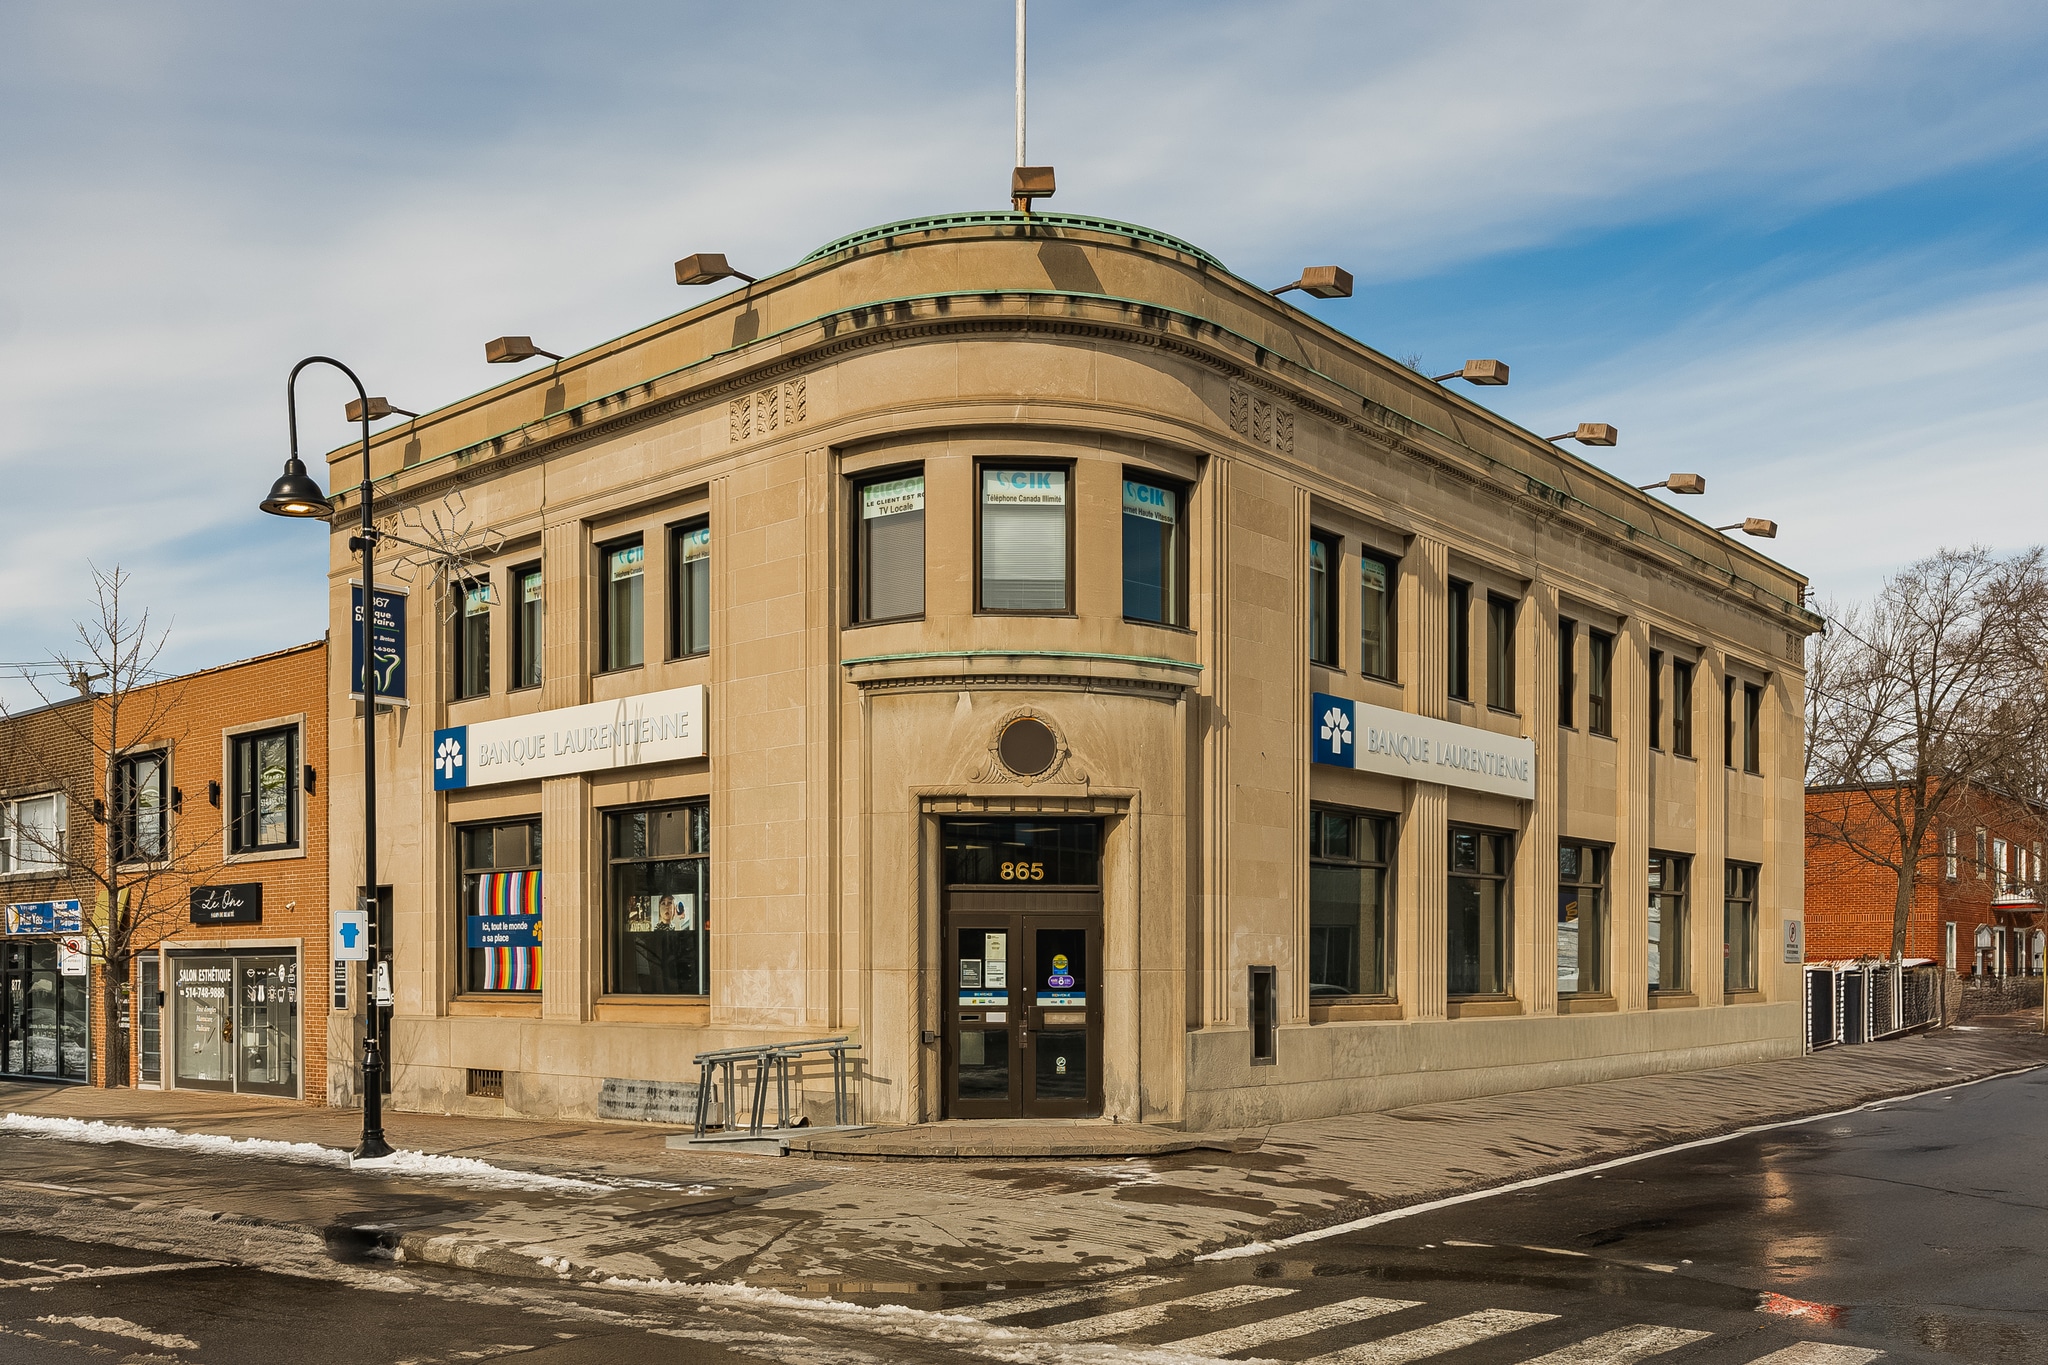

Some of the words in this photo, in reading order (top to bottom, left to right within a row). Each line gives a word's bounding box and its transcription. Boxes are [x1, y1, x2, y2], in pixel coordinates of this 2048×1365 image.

[1011, 472, 1052, 489] CIK
[876, 496, 901, 506] CLIENT
[986, 493, 1018, 503] Téléphone
[1018, 494, 1041, 503] Canada
[1041, 495, 1062, 503] Illimité
[1137, 485, 1165, 507] CIK
[879, 506, 889, 516] TV
[890, 502, 914, 514] Locale
[1138, 507, 1154, 518] Haute
[1154, 511, 1174, 523] Vitesse
[478, 734, 546, 767] BANQUE
[553, 711, 689, 757] LAURENTIENNE
[1367, 726, 1430, 766] BANQUE
[1435, 740, 1528, 782] LAURENTIENNE
[1000, 861, 1044, 880] 865
[482, 922, 491, 932] Ici,
[491, 922, 502, 931] tout
[503, 922, 508, 931] le
[508, 921, 528, 931] monde
[494, 934, 510, 944] place
[179, 969, 197, 982] SALON
[198, 966, 231, 983] ESTHÉTIQUE
[11, 979, 21, 991] 877
[185, 987, 225, 998] 514-748-9888
